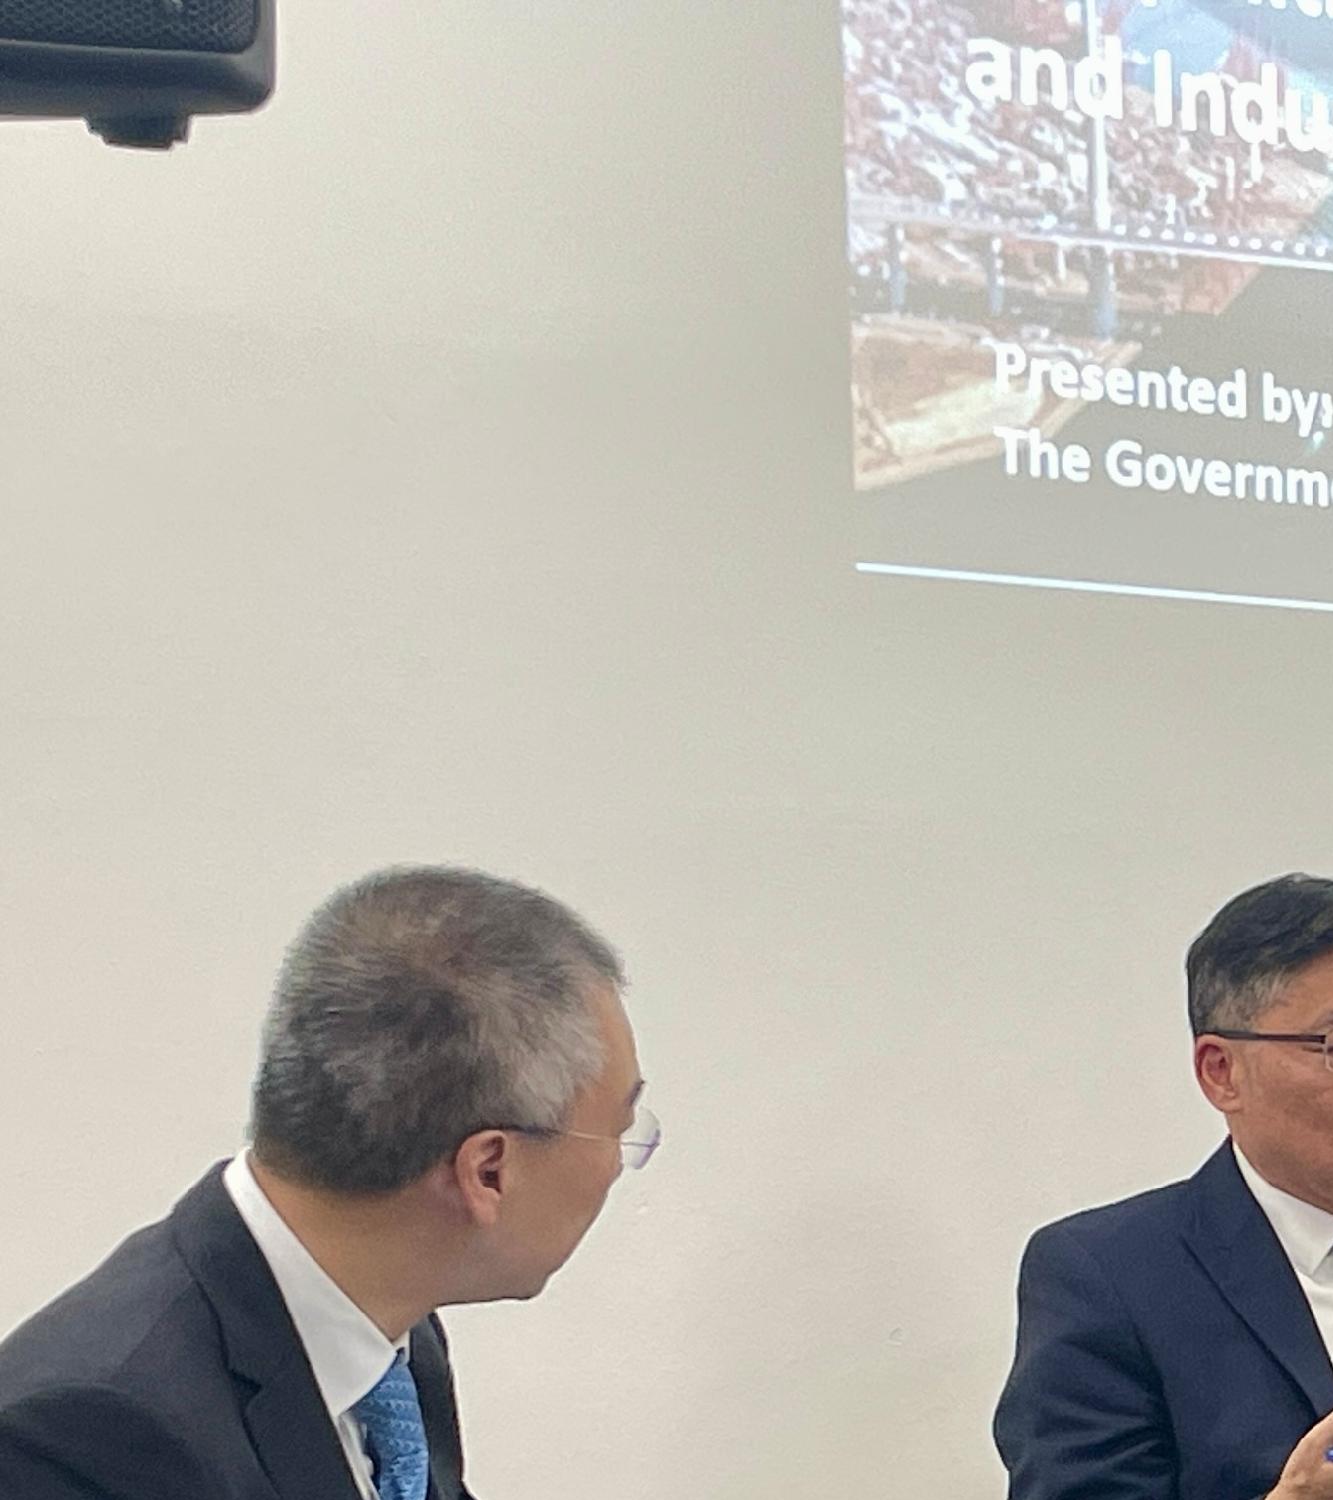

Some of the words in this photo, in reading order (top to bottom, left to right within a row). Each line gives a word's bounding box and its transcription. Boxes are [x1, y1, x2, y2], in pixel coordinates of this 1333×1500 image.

[965, 34, 1123, 120] and
[992, 339, 1247, 419] Presented
[994, 425, 1091, 482] The
